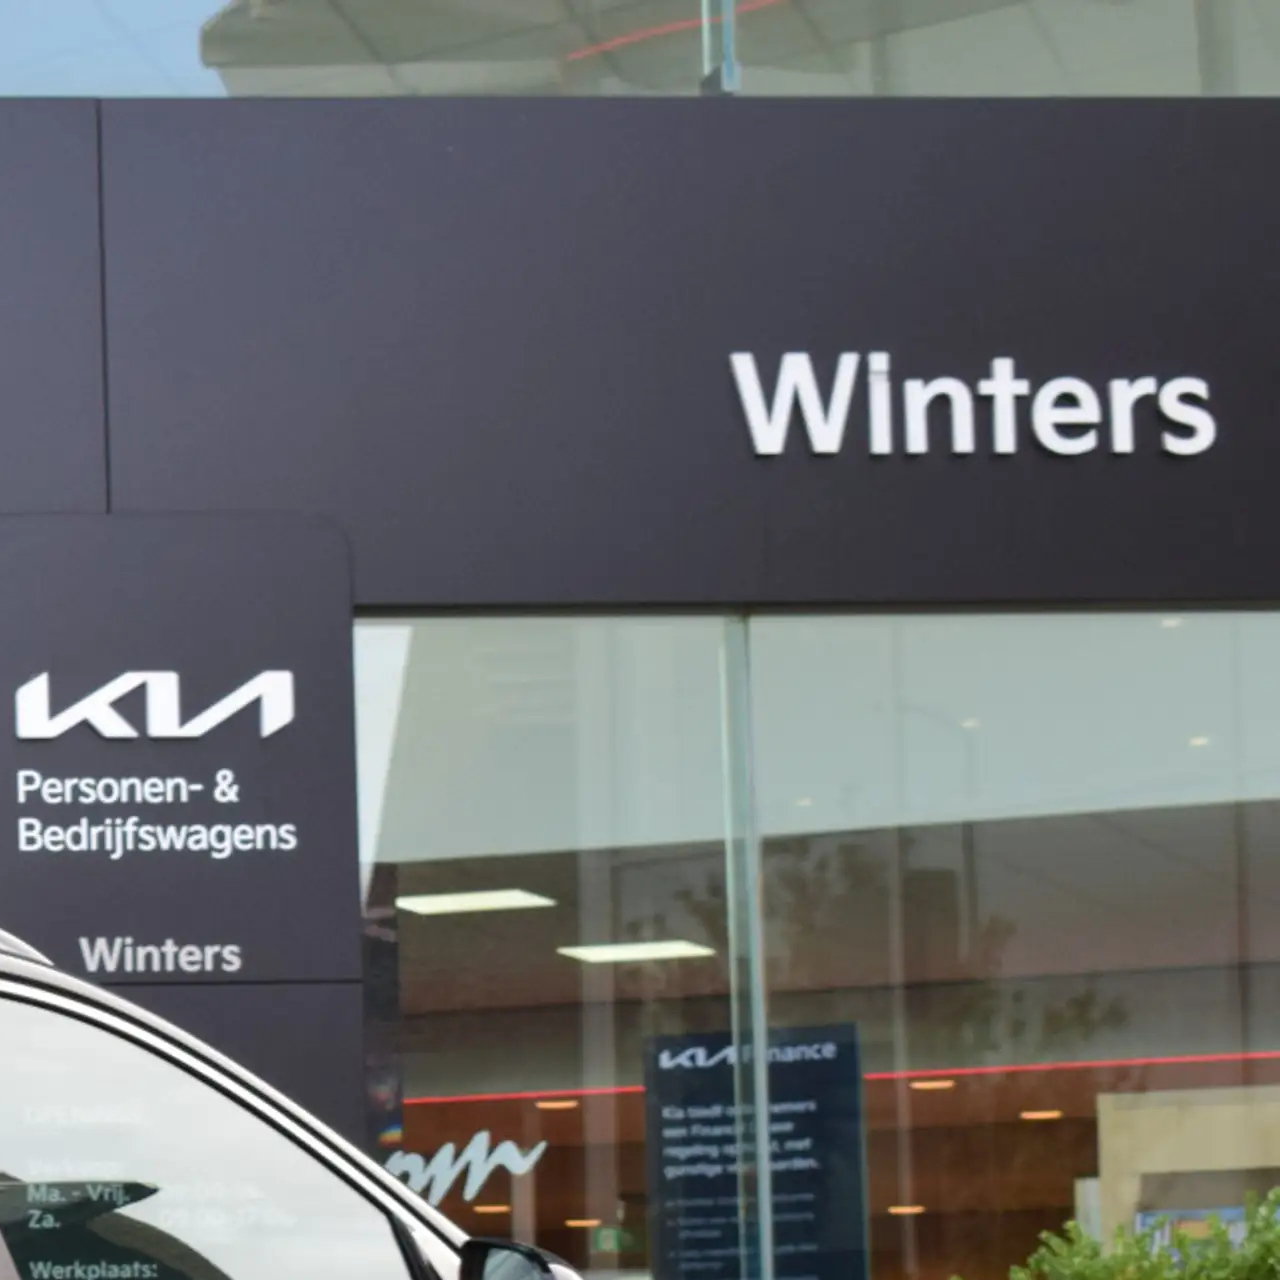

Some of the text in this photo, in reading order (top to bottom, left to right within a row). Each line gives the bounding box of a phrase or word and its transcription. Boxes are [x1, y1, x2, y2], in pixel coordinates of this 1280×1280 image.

[730, 352, 1217, 455] Winters
[15, 670, 295, 739] KIA
[16, 768, 239, 805] Personen- &
[18, 815, 298, 860] Bedrijfswagens
[79, 935, 242, 973] Winters
